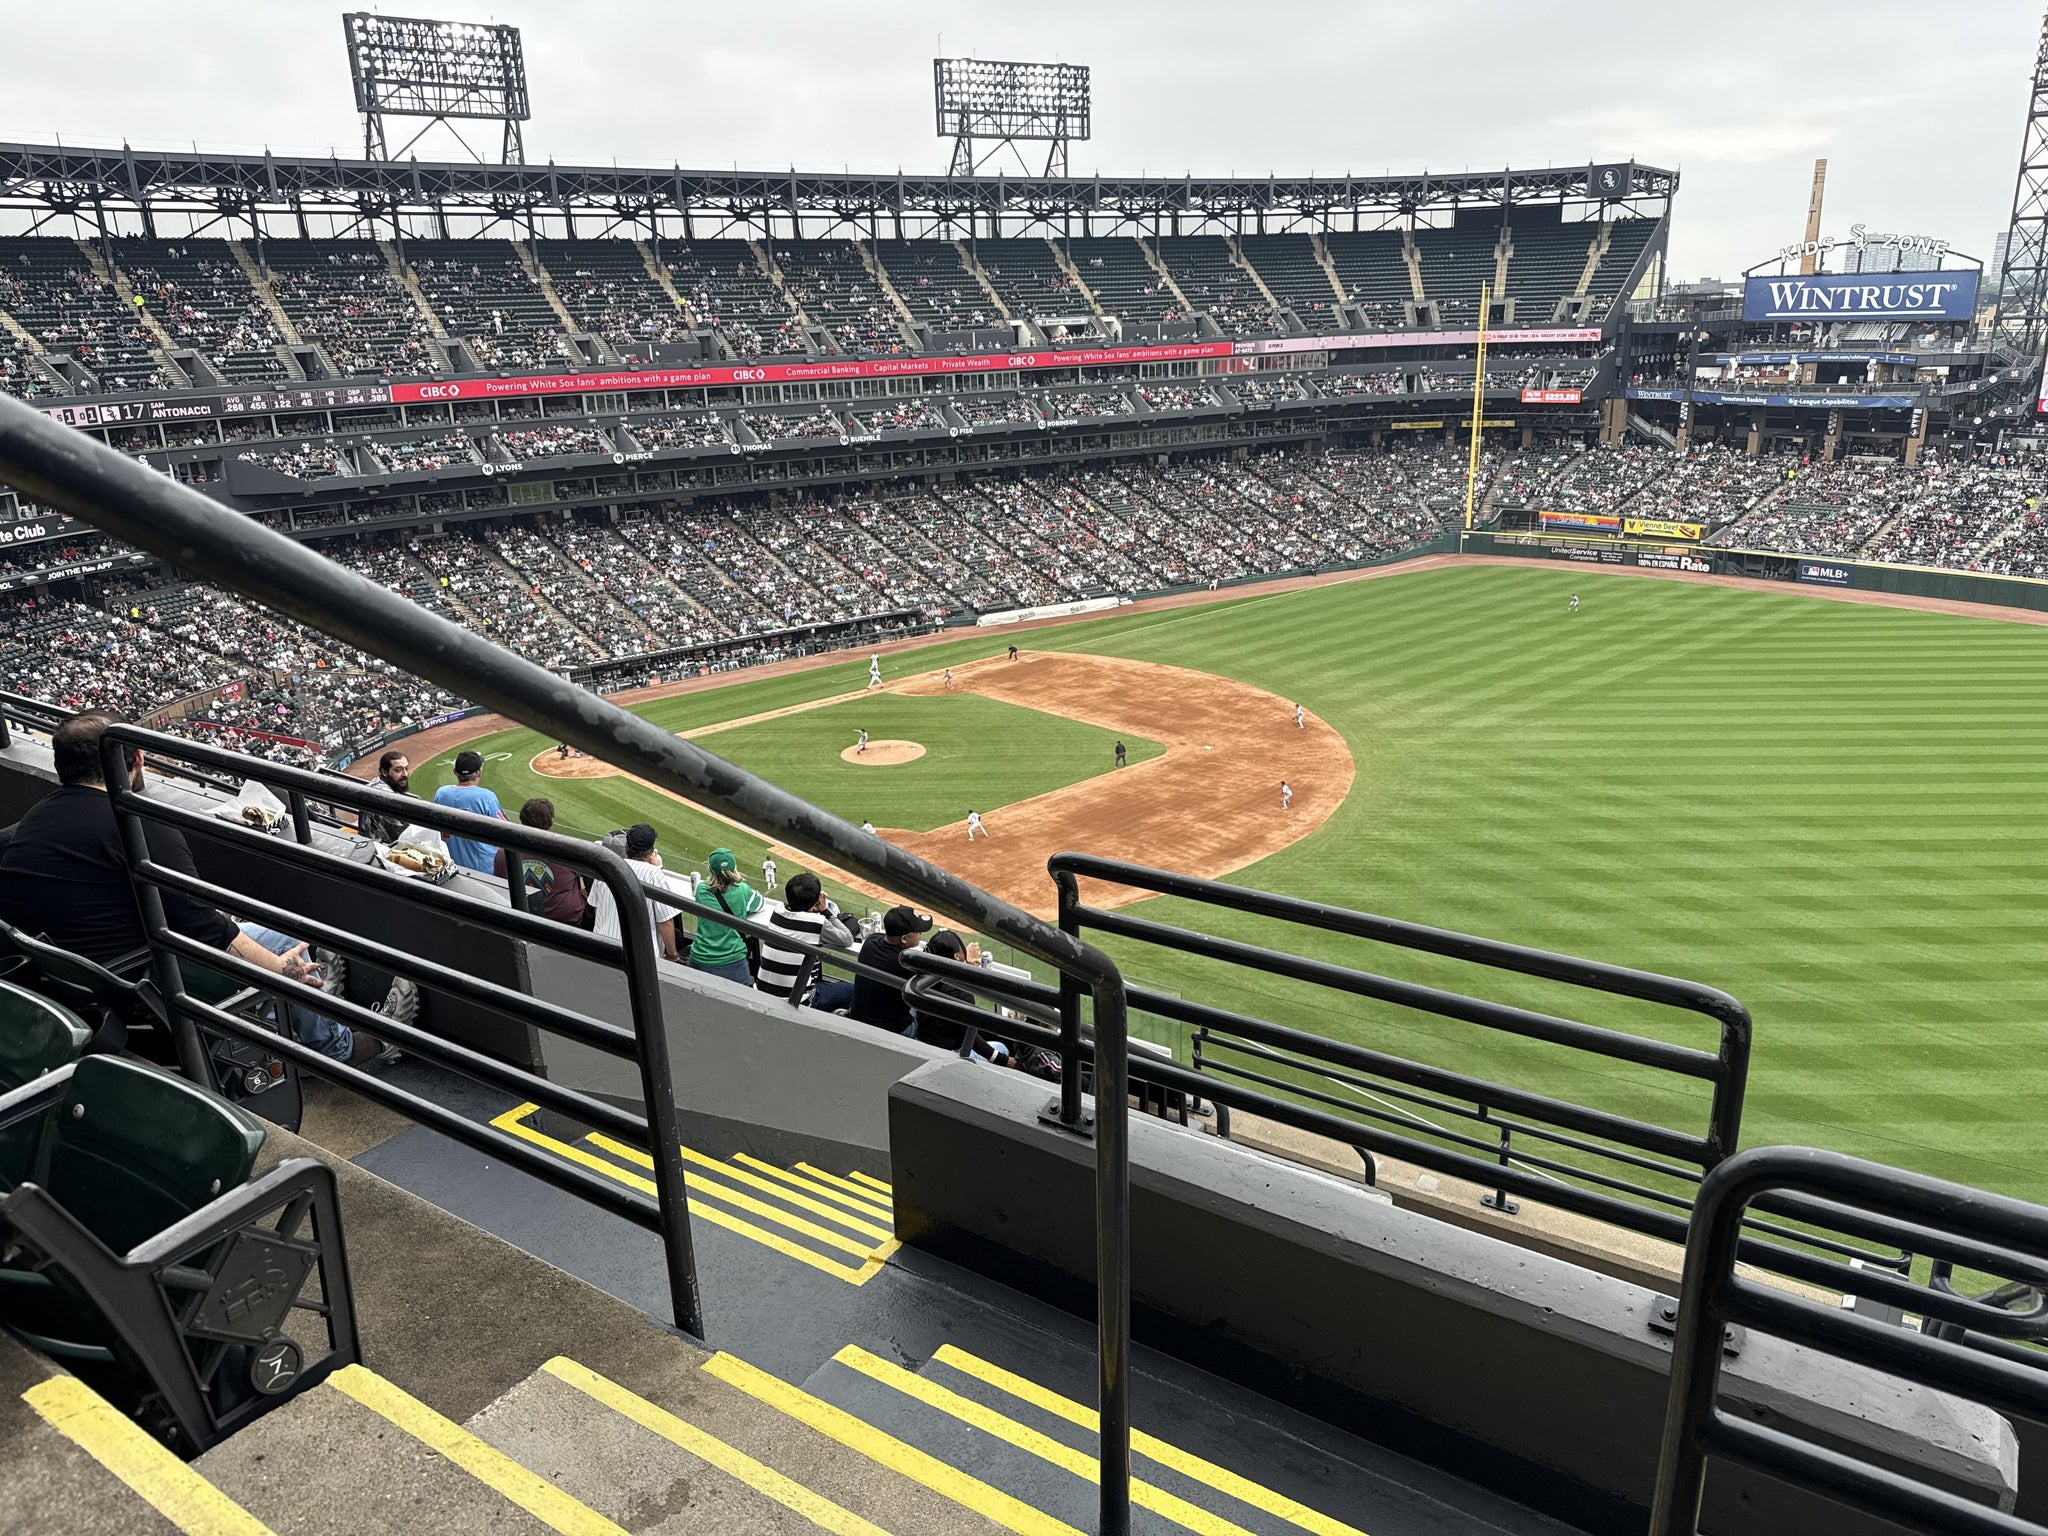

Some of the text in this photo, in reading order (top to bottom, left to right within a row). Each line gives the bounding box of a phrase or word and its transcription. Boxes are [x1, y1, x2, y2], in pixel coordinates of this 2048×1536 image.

[1779, 237, 1835, 263] KIDS
[1882, 234, 1949, 258] ZONE
[1769, 282, 1952, 310] WINTRUST
[1053, 354, 1082, 363] Powering
[1083, 352, 1103, 361] White
[1104, 351, 1115, 359] Sox
[1132, 348, 1163, 358] ambitions
[1164, 347, 1177, 356] with
[1183, 348, 1200, 356] game
[1201, 346, 1215, 355] plan
[1008, 356, 1027, 366] CIBC
[786, 358, 991, 377] Commercial Banking Capital Markets Private Wealth
[733, 370, 756, 380] CIBC
[486, 381, 528, 392] Powering
[529, 379, 557, 389] White
[559, 378, 575, 387] Sox
[600, 374, 641, 386] ambitions
[643, 373, 661, 383] with
[670, 374, 692, 384] game
[694, 372, 711, 382] plan
[420, 386, 448, 397] CIBC
[301, 399, 313, 407] 45
[345, 396, 364, 404] .364
[369, 394, 387, 402] .389
[1821, 398, 1859, 406] Capabilities
[225, 403, 244, 412] .268
[250, 402, 267, 410] 455
[274, 400, 292, 408] 122
[57, 414, 63, 422] S
[65, 411, 74, 423] 1
[87, 410, 95, 421] 1
[123, 403, 144, 420] 17
[152, 406, 211, 418] ANTONACCI
[1047, 419, 1078, 428] ROBINSON
[851, 435, 881, 443] BUEHRLE
[743, 443, 772, 452] THOMAS
[625, 452, 653, 462] PIERCE
[495, 463, 523, 473] LYONS
[1639, 520, 1679, 531] Vienna Beef
[14, 524, 46, 540] Club
[1569, 554, 1598, 562] Companies
[1638, 559, 1652, 567] 100%
[1659, 560, 1679, 569] ESPAÑOL
[1680, 557, 1710, 573] Rate
[48, 570, 65, 580] JOIN
[66, 567, 81, 576] THE
[97, 561, 113, 571] APP
[1820, 567, 1848, 578] MLB+
[269, 1358, 283, 1375] 7
